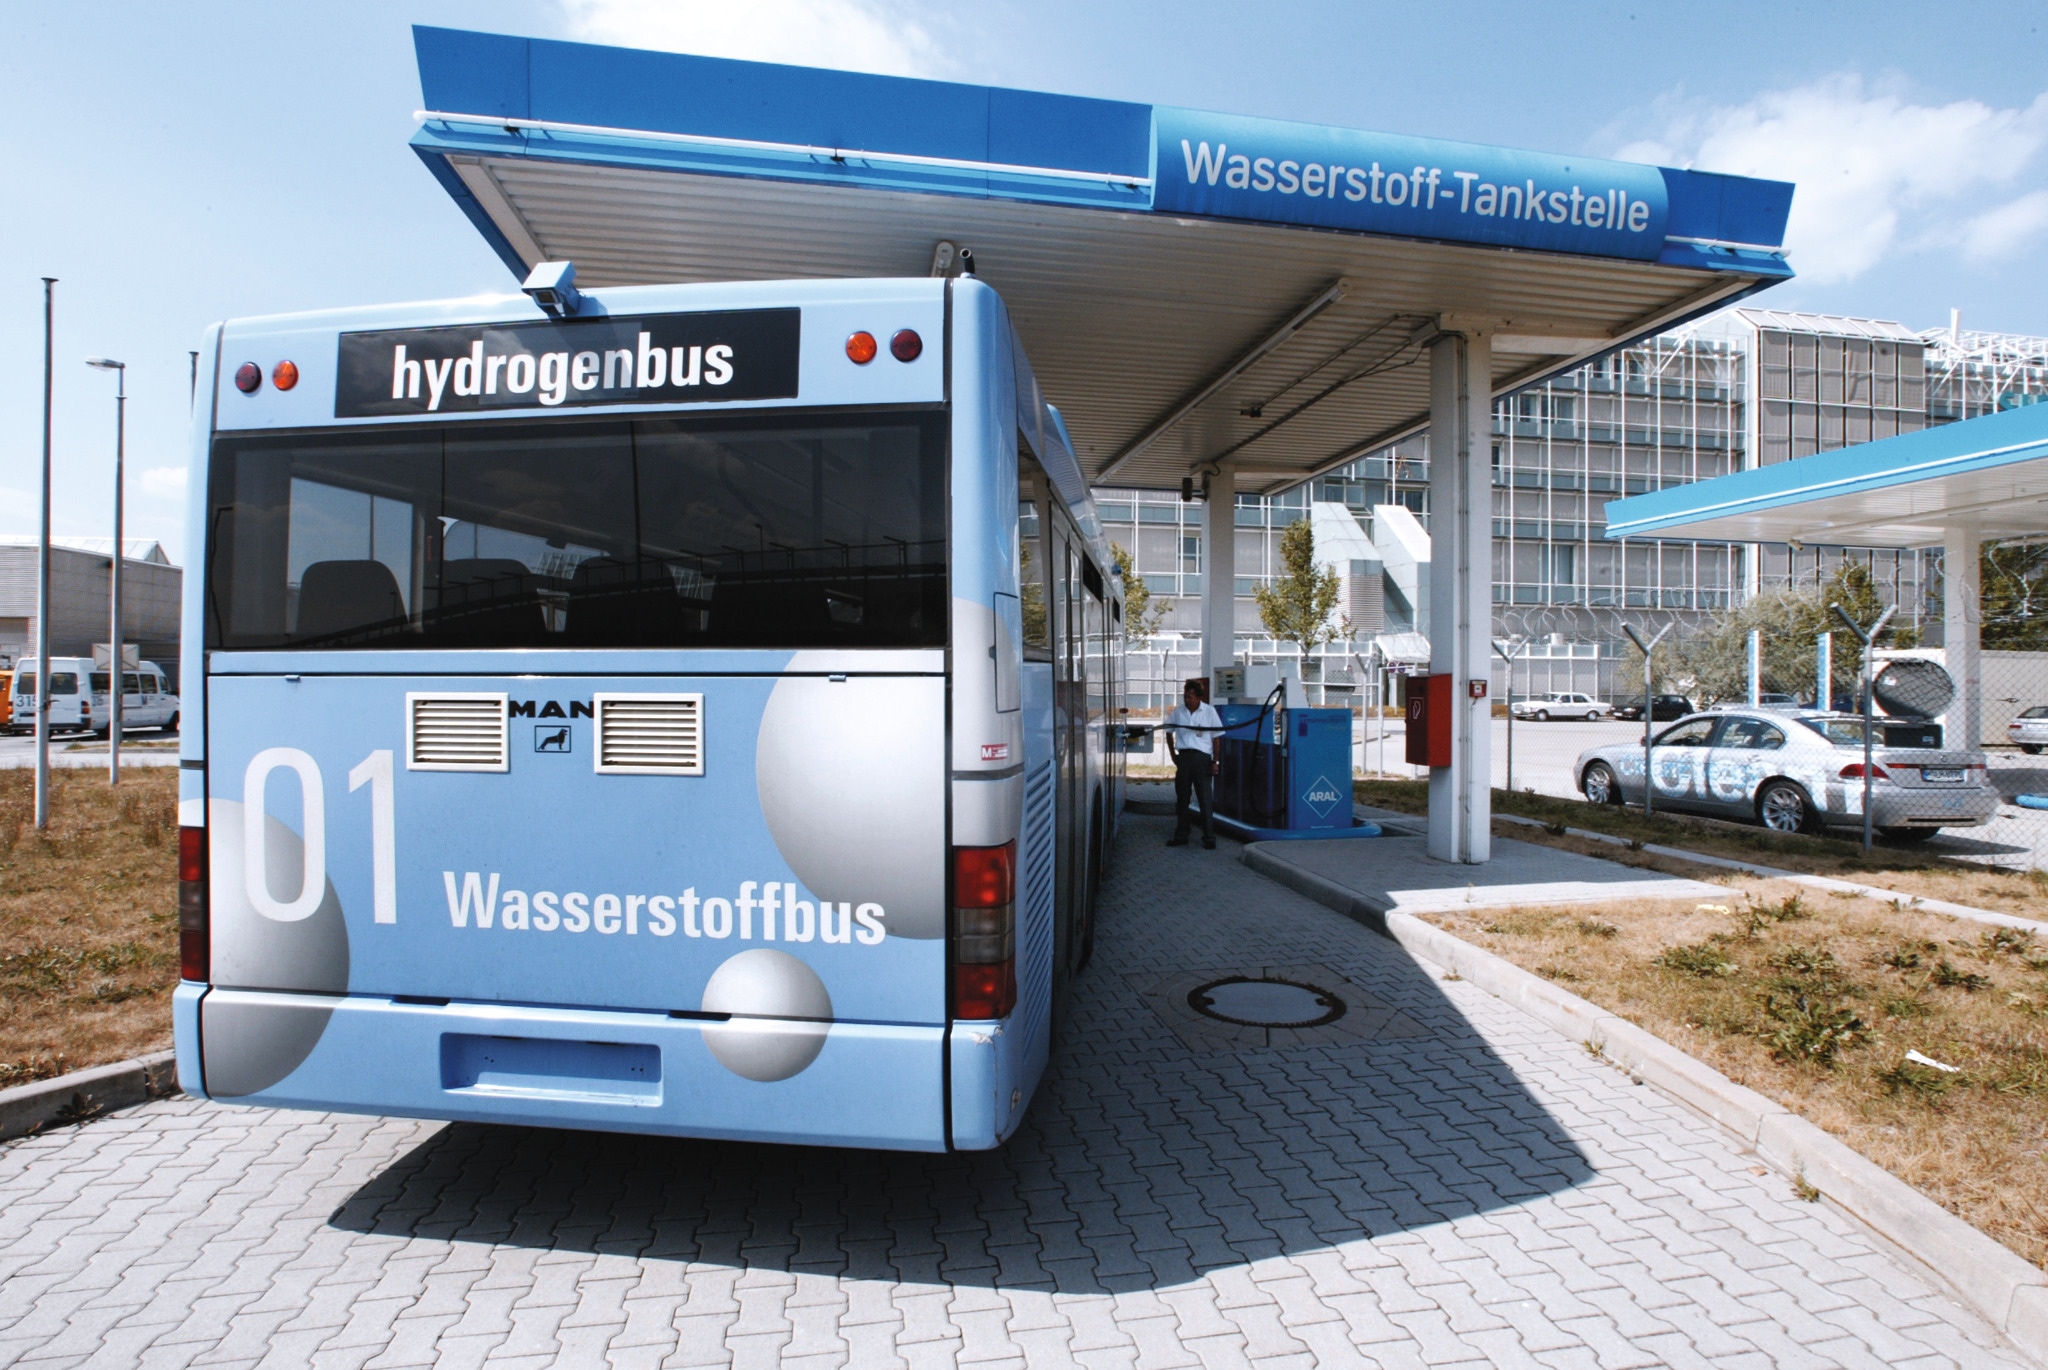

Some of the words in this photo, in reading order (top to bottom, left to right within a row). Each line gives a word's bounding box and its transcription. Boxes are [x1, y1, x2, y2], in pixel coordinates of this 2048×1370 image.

[1181, 139, 1650, 233] Wasserstoff-Tankstelle
[392, 332, 734, 411] hydrogenbus
[508, 700, 595, 718] MAN
[1309, 791, 1337, 802] ARAL
[243, 747, 396, 924] 01
[442, 871, 886, 945] Wasserstoffbus
